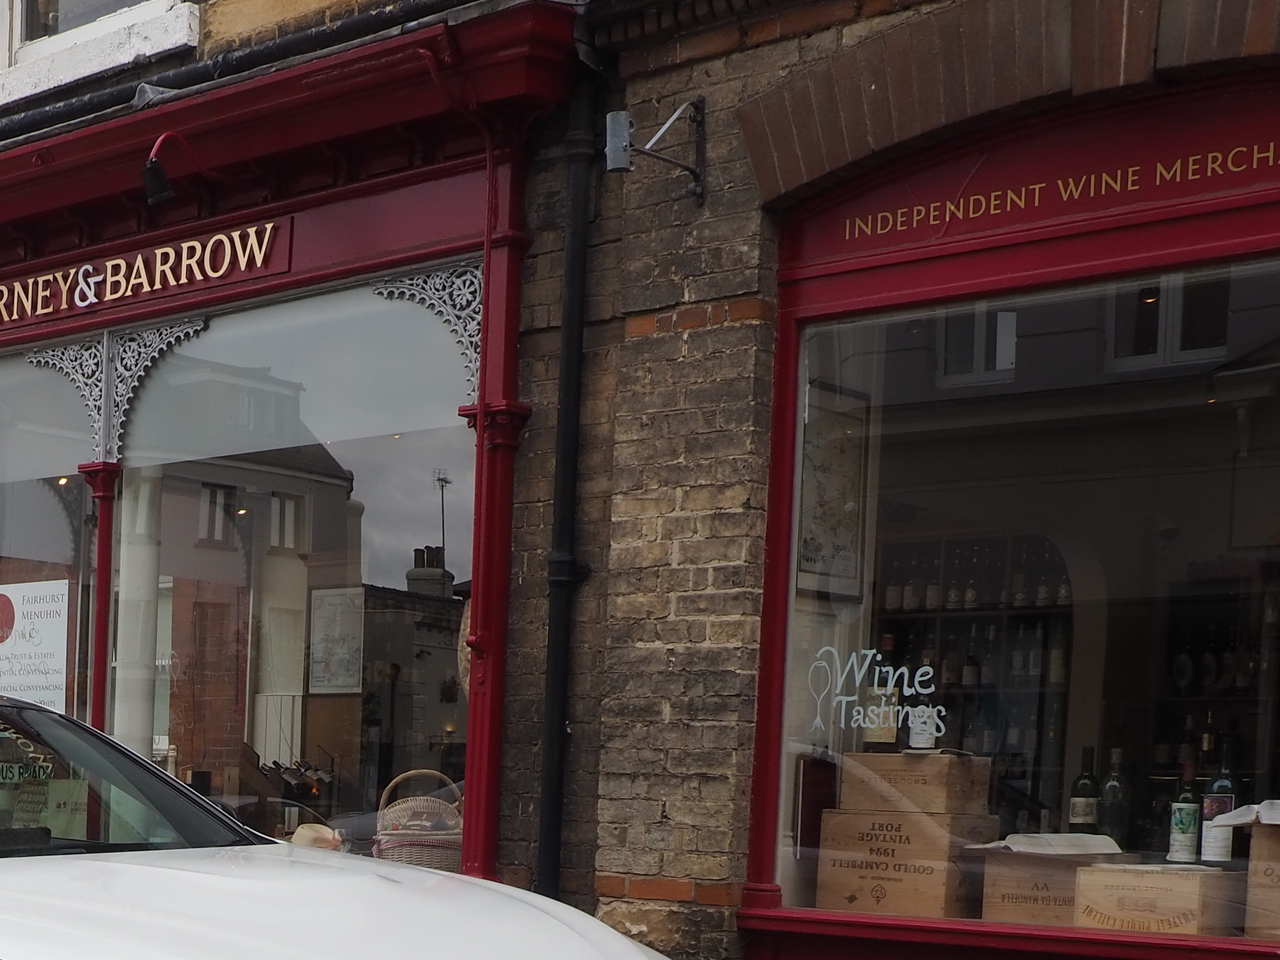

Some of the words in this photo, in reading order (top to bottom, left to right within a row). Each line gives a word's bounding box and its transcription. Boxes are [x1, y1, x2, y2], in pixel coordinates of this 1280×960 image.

[843, 182, 1046, 240] INDEPENDENT
[1057, 166, 1141, 203] WINE
[1155, 142, 1280, 186] MERCH
[22, 593, 66, 606] FAIRHURST
[21, 609, 62, 621] MENUHIN
[10, 652, 28, 660] TRUST
[34, 652, 56, 660] ESTATES
[816, 645, 936, 697] Wine
[19, 683, 64, 692] CONVEYANCING
[831, 695, 947, 738] Tastings
[869, 822, 903, 833] PORT
[857, 832, 911, 845] VINTAGE
[869, 846, 896, 858] 1994
[830, 858, 889, 872] CAMPBELL
[893, 863, 935, 876] GOULD
[1040, 895, 1051, 906] DA
[1053, 895, 1076, 907] UINTA
